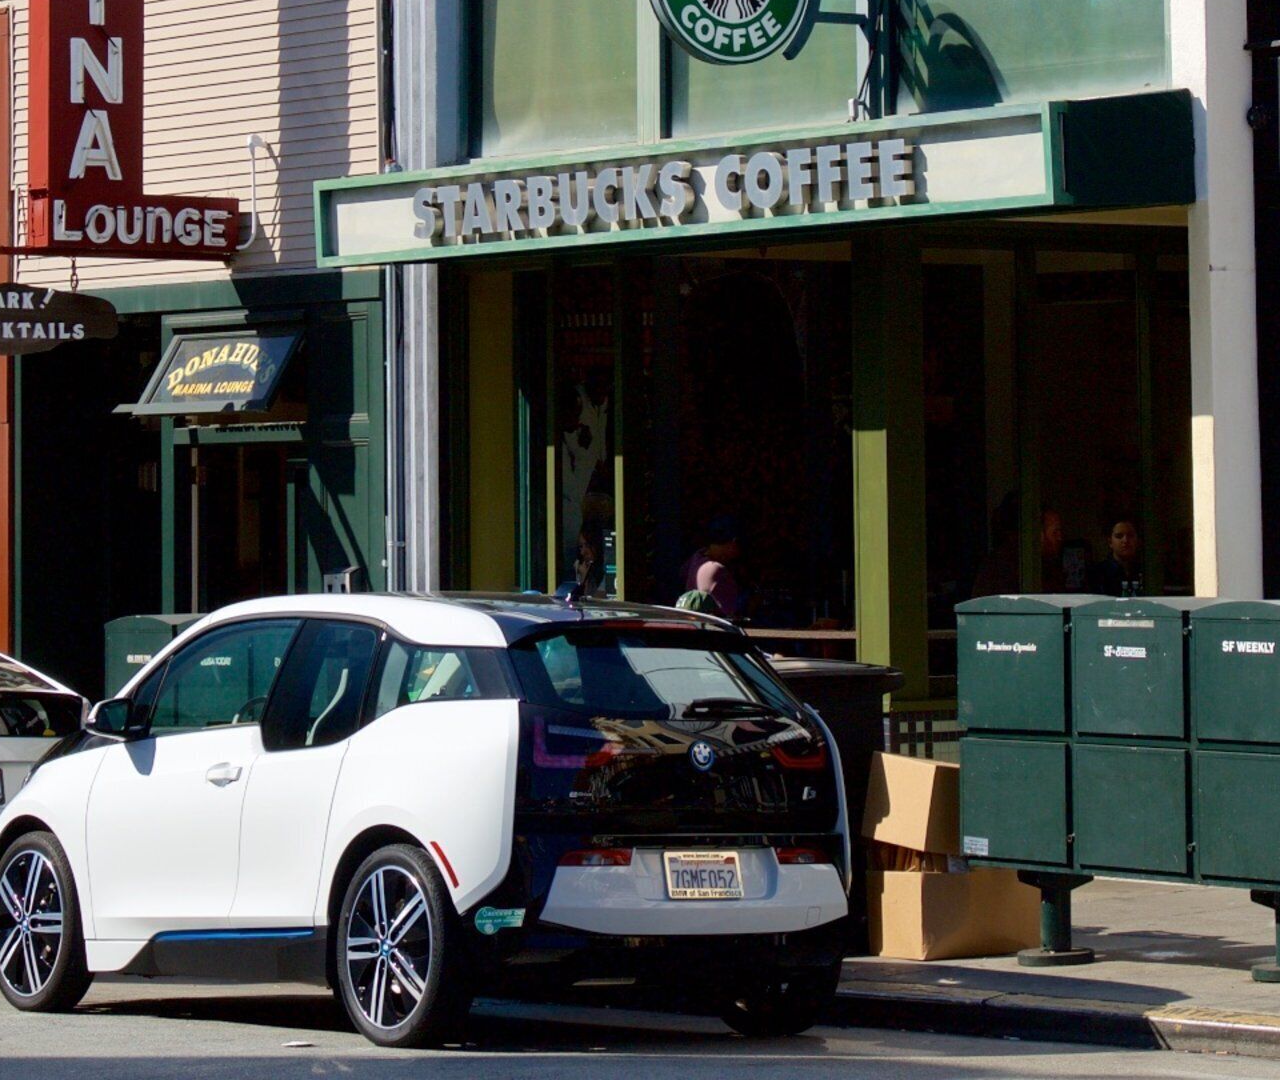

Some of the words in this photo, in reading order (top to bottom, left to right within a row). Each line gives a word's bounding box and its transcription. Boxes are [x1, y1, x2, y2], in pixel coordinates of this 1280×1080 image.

[681, 9, 783, 53] COFFEE
[412, 161, 694, 242] STARBUCKS
[716, 136, 916, 214] COFFEE
[53, 198, 230, 248] LOUNGE
[172, 382, 211, 396] MARINA
[214, 380, 255, 394] LOUNGE
[1222, 640, 1235, 653] SF
[1236, 641, 1276, 653] WEEKLY
[672, 869, 735, 889] 7GMF052
